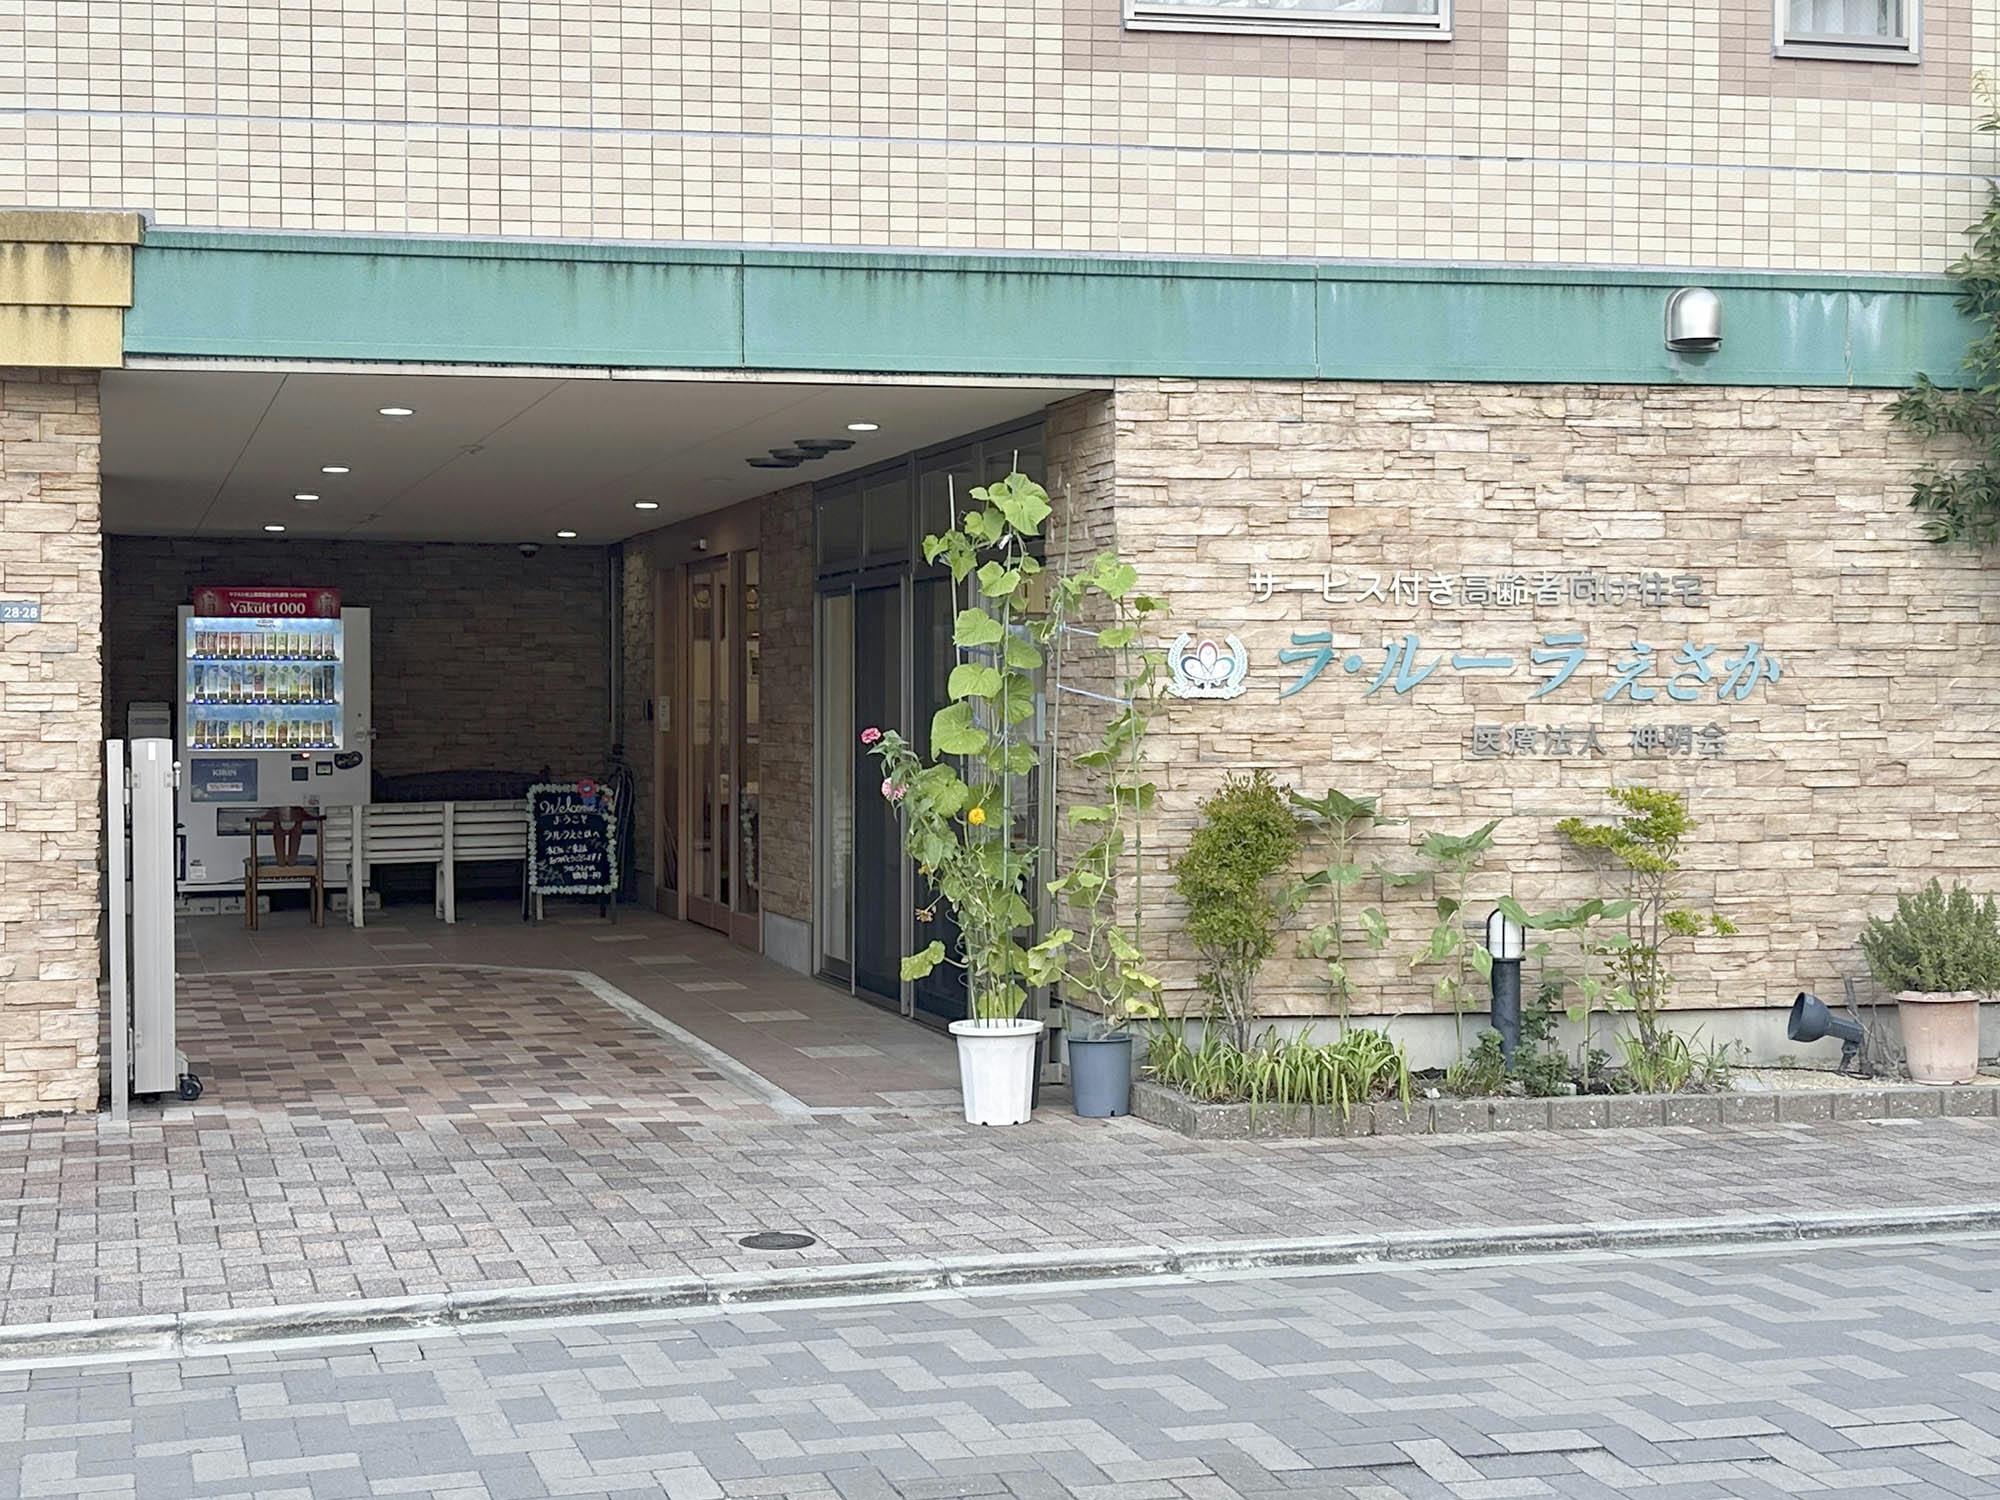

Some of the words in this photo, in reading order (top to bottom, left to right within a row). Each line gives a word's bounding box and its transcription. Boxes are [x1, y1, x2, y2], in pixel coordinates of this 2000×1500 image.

[1248, 569, 1706, 606] サービス付き高齢者向け住宅
[1472, 724, 1607, 757] 医療法人
[1629, 722, 1727, 757] 神明会
[539, 796, 598, 814] Welcome
